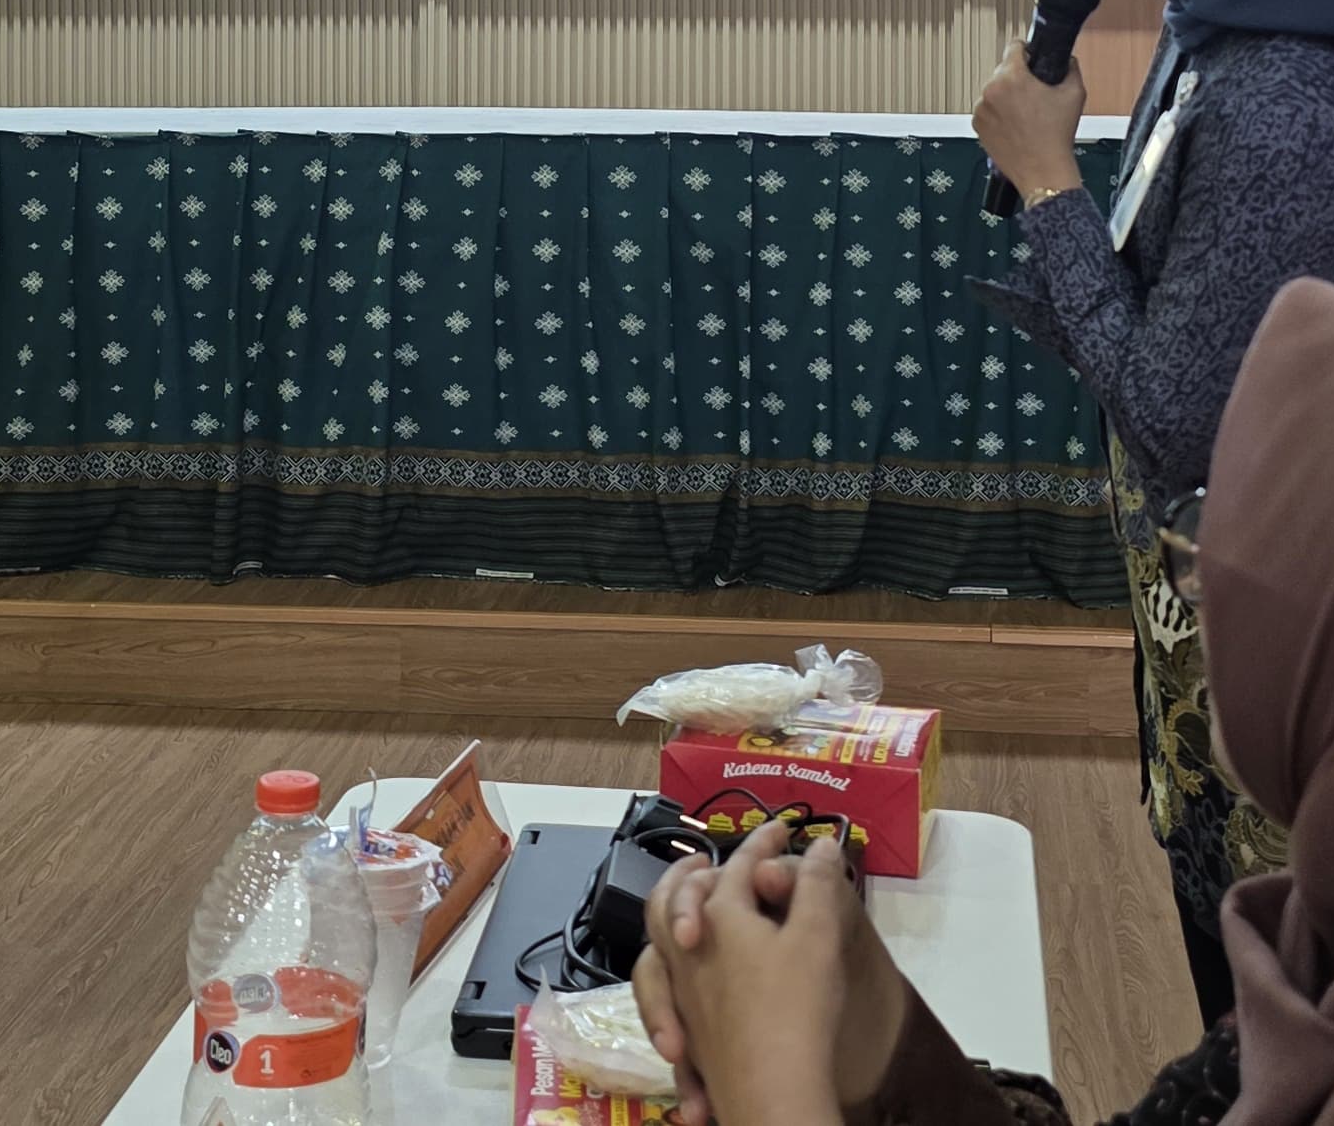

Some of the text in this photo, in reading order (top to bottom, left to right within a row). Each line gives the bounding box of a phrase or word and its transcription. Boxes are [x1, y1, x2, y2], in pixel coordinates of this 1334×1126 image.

[722, 761, 852, 792] Karena Sambal
[210, 1038, 233, 1065] Cleo
[259, 1049, 275, 1075] 1
[530, 1059, 556, 1097] Pesan
